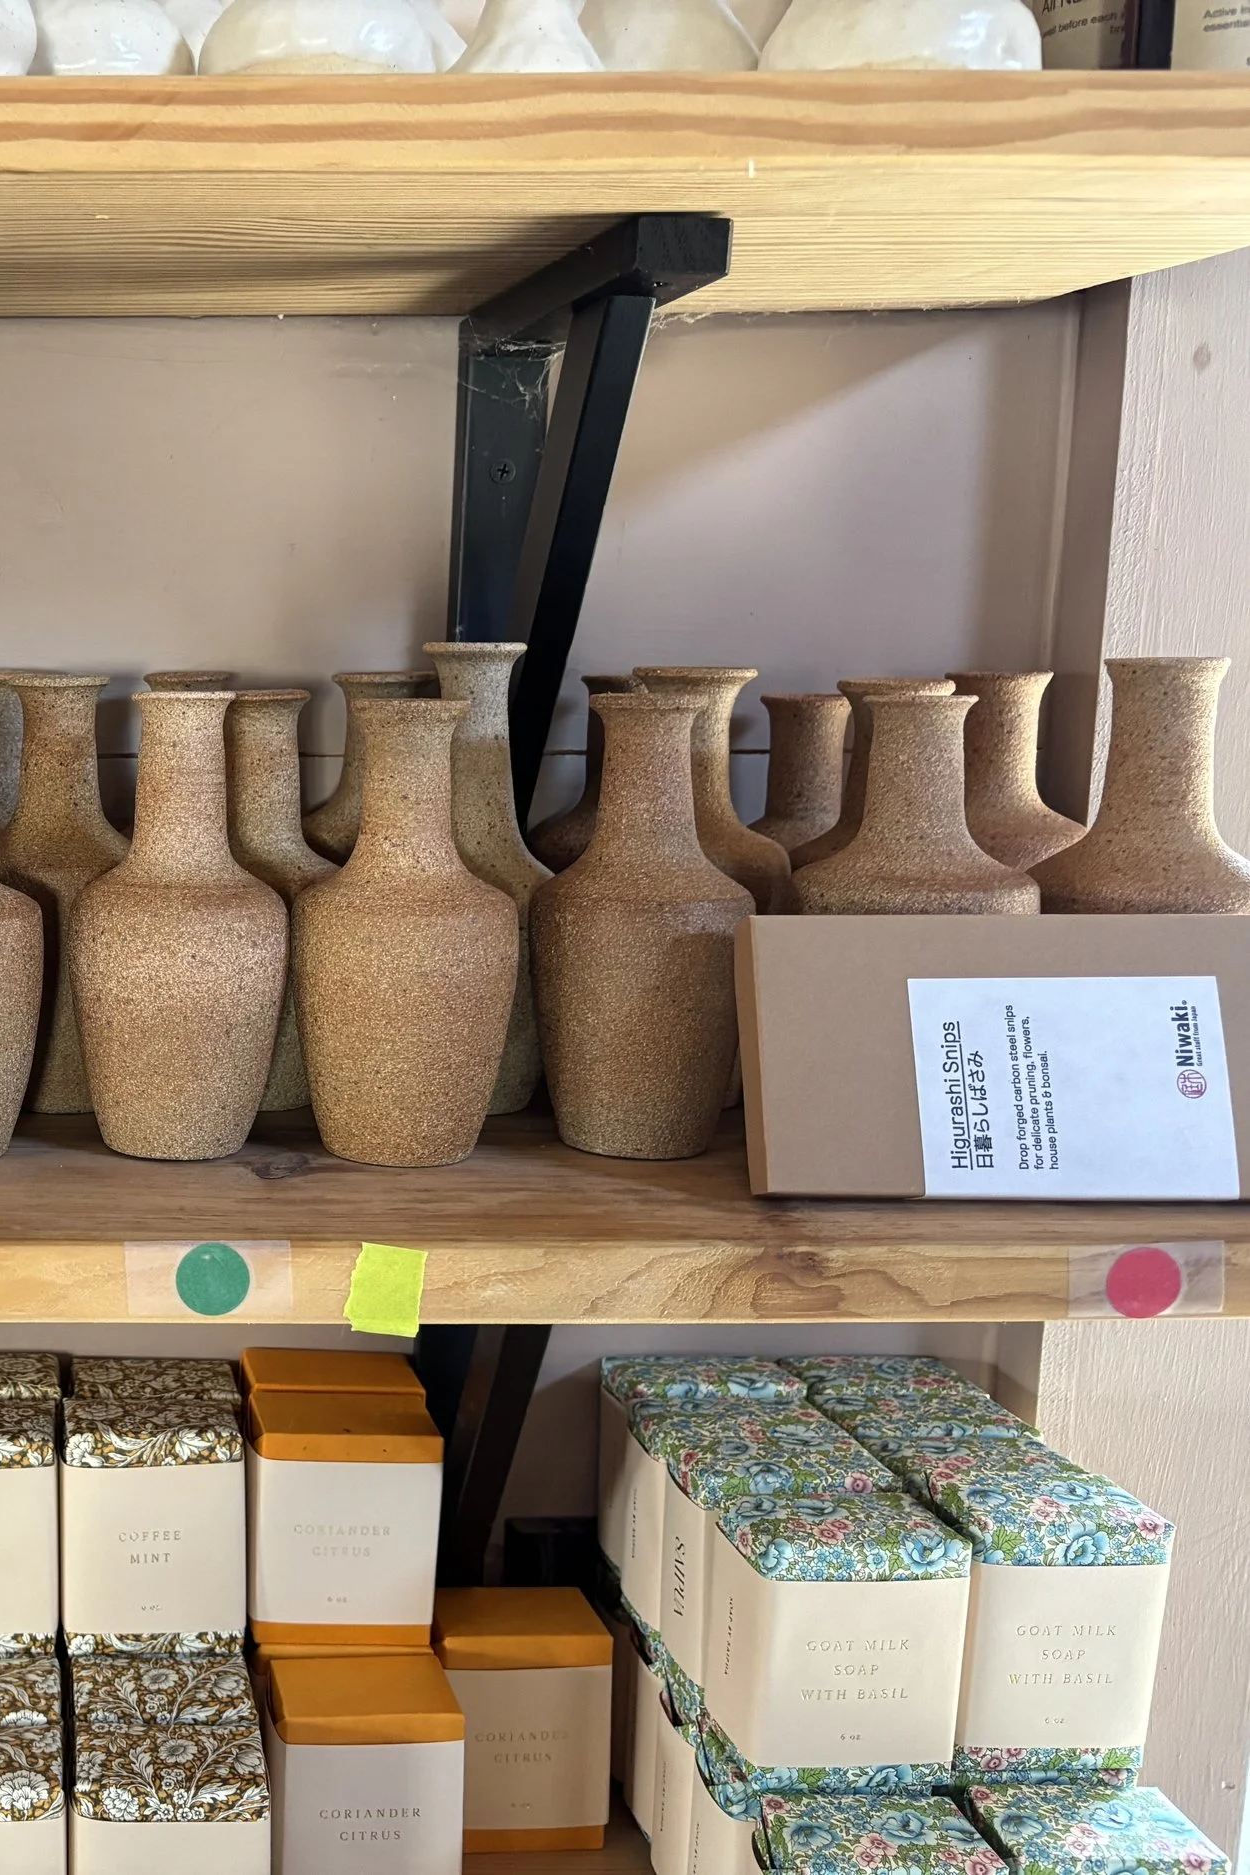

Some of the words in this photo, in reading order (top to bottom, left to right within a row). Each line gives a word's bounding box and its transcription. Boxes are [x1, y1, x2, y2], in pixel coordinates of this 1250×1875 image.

[1003, 1004, 1017, 1034] snips
[940, 1021, 961, 1074] Snips
[1005, 1034, 1018, 1062] steel
[1021, 1016, 1034, 1060] flowers,
[1037, 1050, 1050, 1089] bonsai.
[1008, 1063, 1023, 1102] carbon
[1025, 1061, 1040, 1105] pruning,
[1041, 1090, 1052, 1099] &
[967, 1050, 994, 1169] 日暮らしばさみ
[1044, 1100, 1059, 1134] plants
[944, 1078, 971, 1169] Higurashi
[1013, 1104, 1028, 1141] forged
[1029, 1109, 1042, 1151] delicate
[1018, 1145, 1030, 1170] Drop
[1033, 1151, 1044, 1170] for
[1048, 1135, 1059, 1170] house
[118, 1530, 182, 1543] COFFEE
[293, 1524, 391, 1536] CORIANDER
[129, 1553, 171, 1564] MINT
[312, 1546, 371, 1557] CITRUS
[673, 1536, 686, 1617] SAIPUA
[1016, 1625, 1063, 1637] GOAT
[1072, 1625, 1118, 1636] MILK
[806, 1640, 855, 1652] GOAT
[864, 1639, 911, 1651] MILK
[1041, 1649, 1087, 1661] SOAP
[833, 1664, 880, 1676] SOAP
[1008, 1673, 1054, 1685] WITH
[1063, 1673, 1114, 1685] BASIL
[800, 1688, 848, 1701] WITH
[857, 1687, 909, 1700] BASIL
[494, 1753, 553, 1764] CITRUS
[319, 1808, 422, 1820] CORIANDER
[339, 1830, 402, 1842] CITRUS
